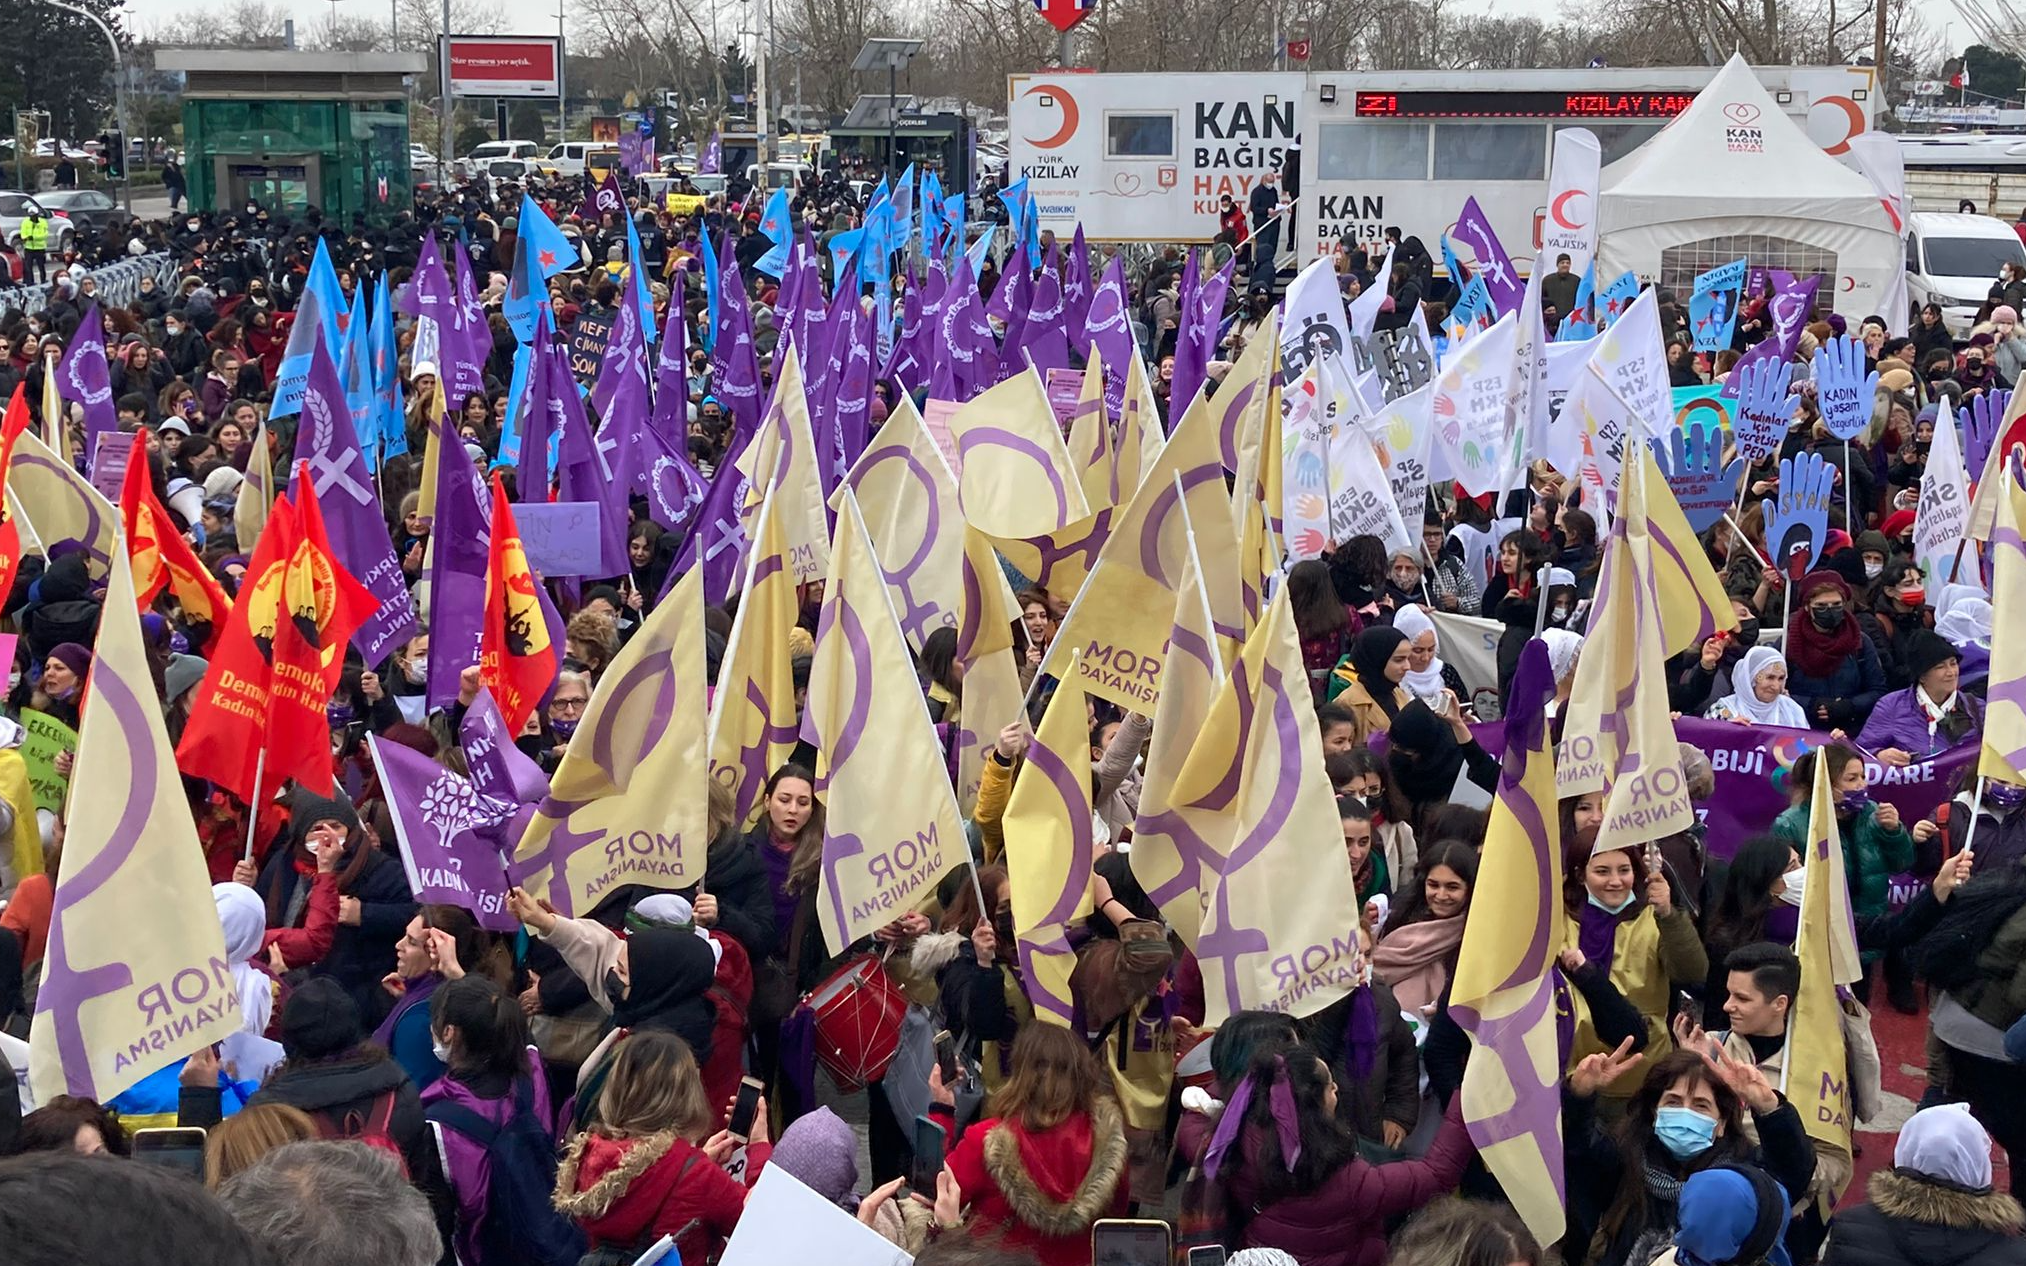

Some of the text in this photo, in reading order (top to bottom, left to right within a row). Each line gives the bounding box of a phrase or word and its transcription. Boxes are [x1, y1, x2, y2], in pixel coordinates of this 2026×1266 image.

[1566, 97, 1643, 111] KIZILAY
[1195, 101, 1294, 139] KAN
[1726, 129, 1762, 138] KAN
[1038, 153, 1064, 164] TÜRK
[1194, 142, 1284, 173] BAĞIŞ
[1021, 165, 1080, 179] KIZILAY
[1318, 196, 1384, 220] KAN
[1318, 221, 1383, 241] BAĞIŞI
[571, 353, 597, 376] SON
[1824, 387, 1858, 403] KADIN
[1740, 407, 1789, 426] Kadınlar
[1826, 401, 1860, 420] yaşam
[1742, 444, 1767, 460] PED
[1668, 473, 1717, 485] ADINLAR
[1083, 640, 1162, 686] MOR
[1712, 744, 1767, 777] BIJÎ
